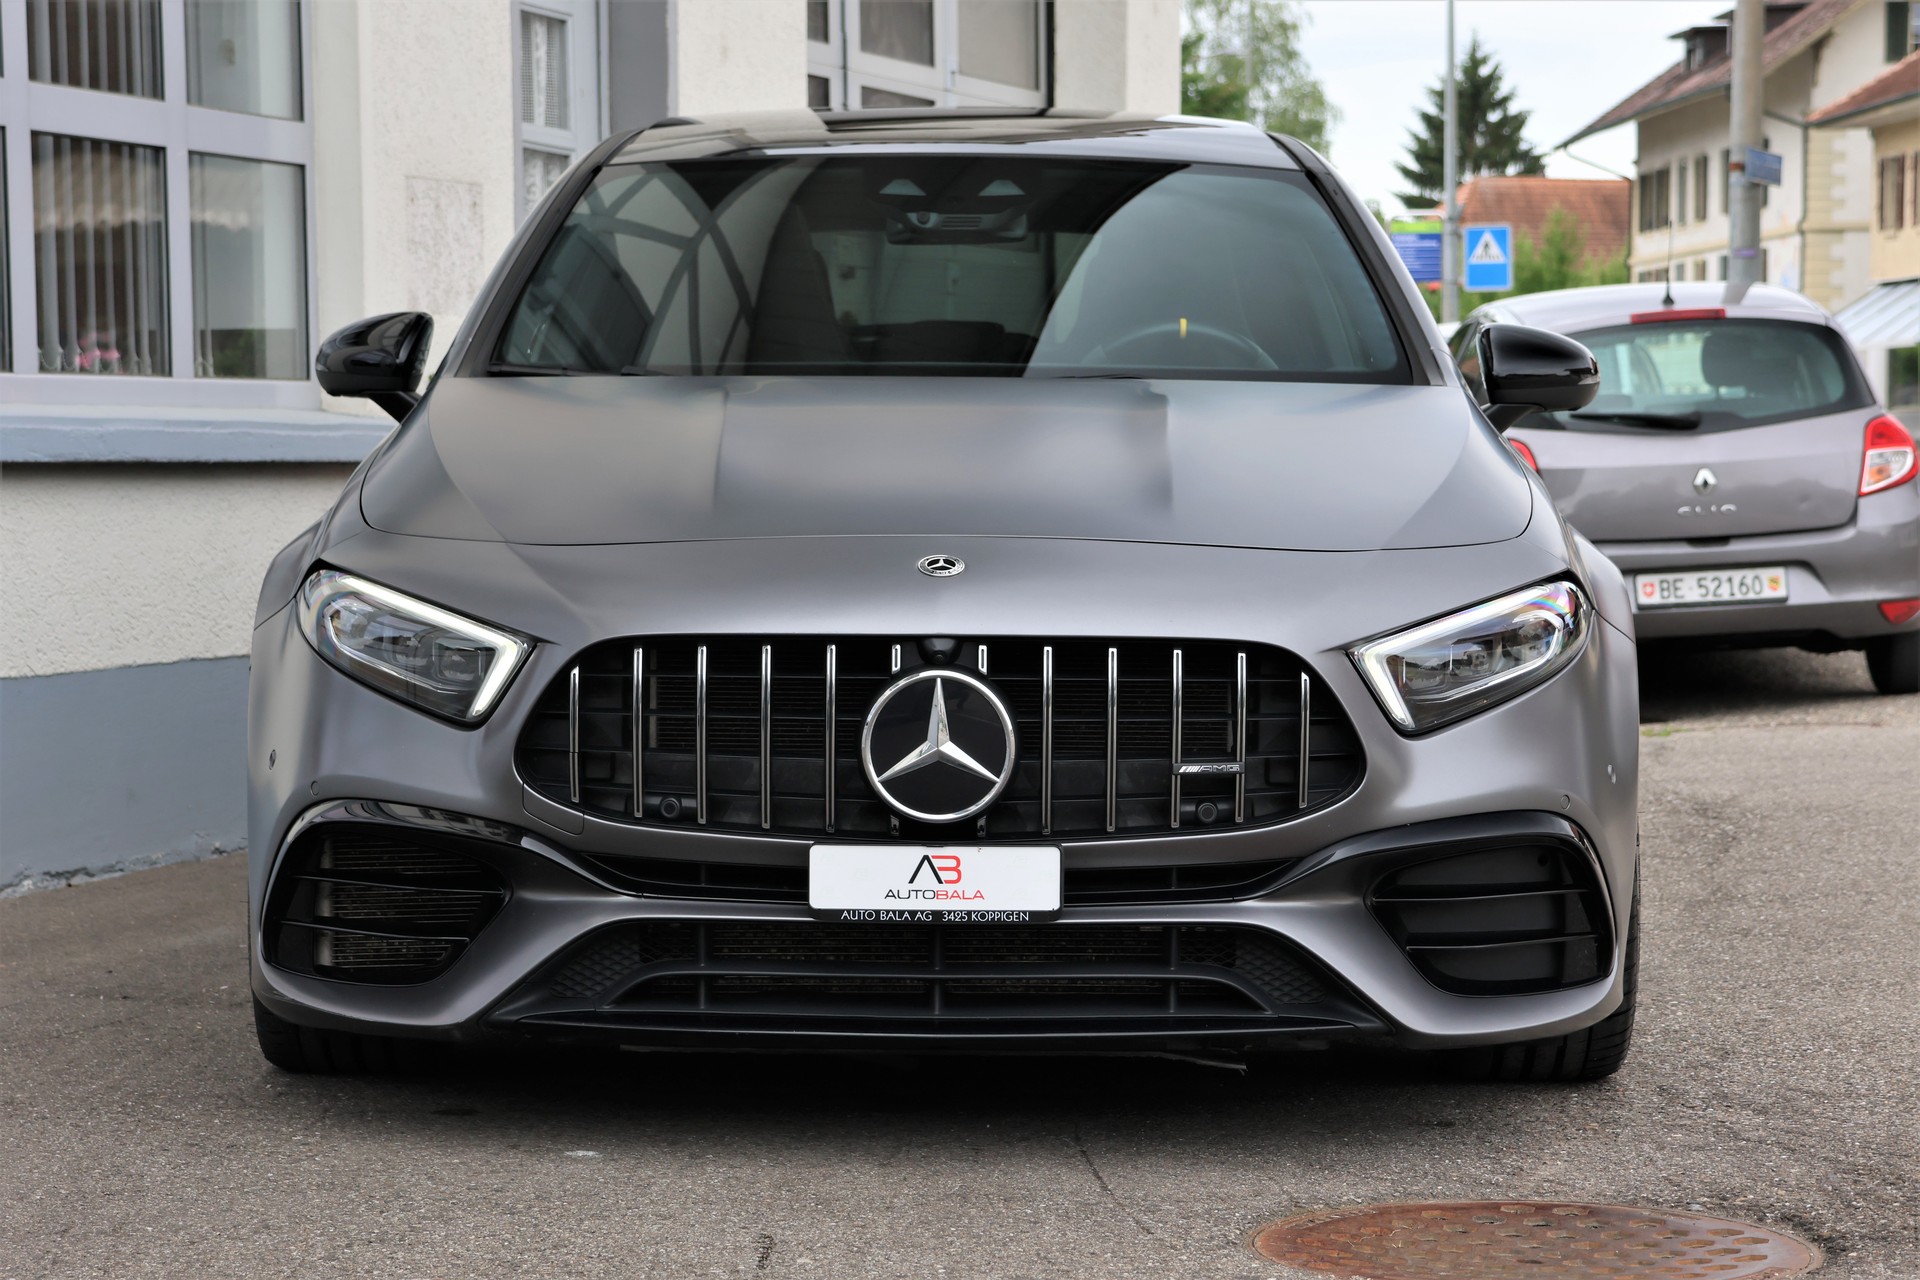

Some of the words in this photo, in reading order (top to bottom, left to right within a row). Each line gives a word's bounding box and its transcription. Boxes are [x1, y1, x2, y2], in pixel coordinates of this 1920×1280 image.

[1697, 575, 1763, 597] 52160
[884, 889, 985, 900] AUTOBALA
[841, 910, 876, 921] AUTO
[880, 910, 912, 921] BALA
[914, 911, 933, 922] AG
[942, 911, 968, 922] 3425
[971, 911, 1029, 922] KOPPIGEN
